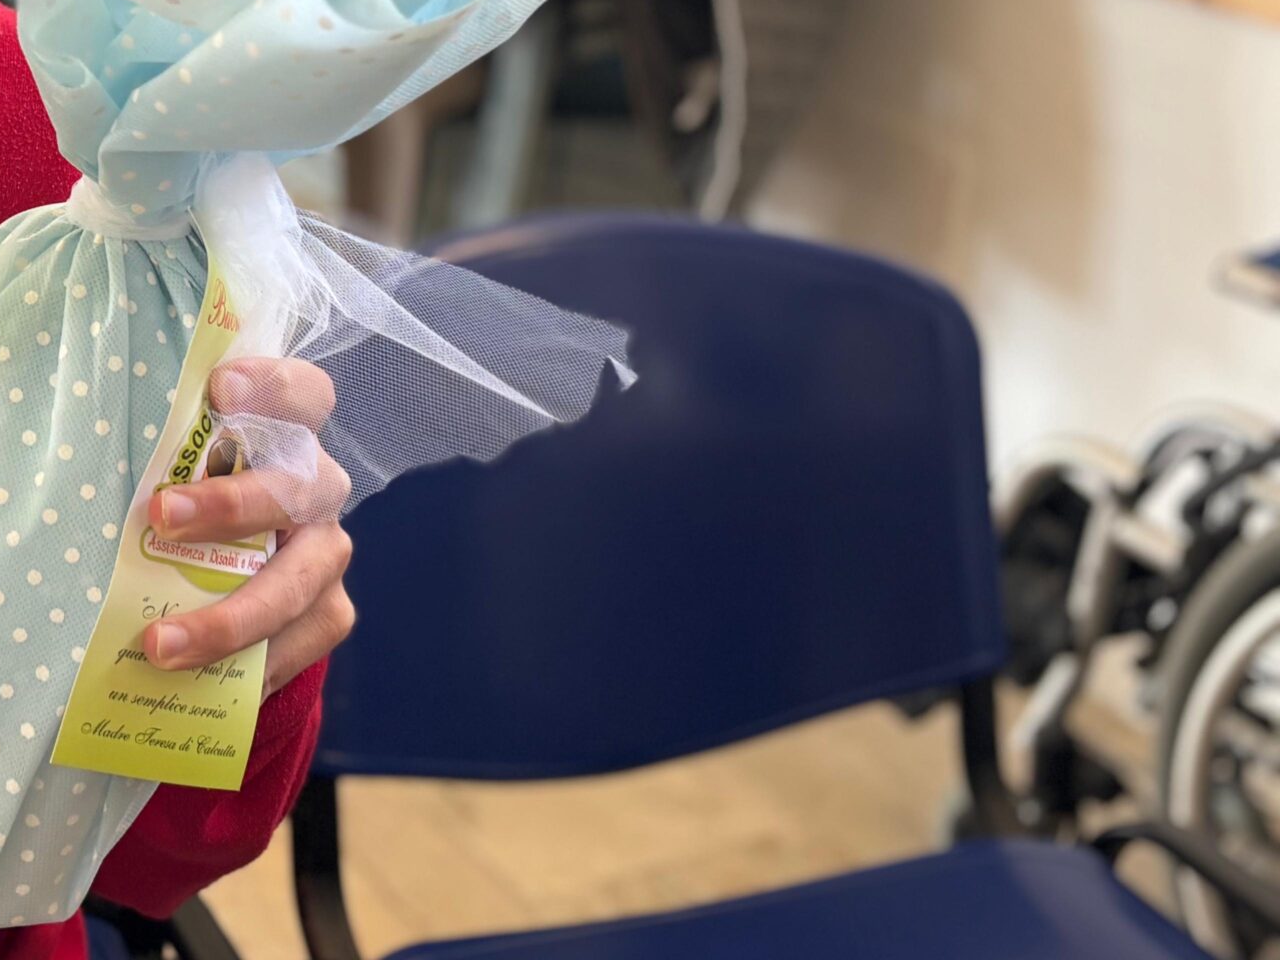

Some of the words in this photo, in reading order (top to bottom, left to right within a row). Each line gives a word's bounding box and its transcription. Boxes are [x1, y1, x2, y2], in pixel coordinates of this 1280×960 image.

[172, 414, 212, 485] SSOC
[148, 533, 205, 561] Assistenza
[219, 657, 246, 686] fare
[108, 690, 129, 704] un
[130, 692, 188, 716] semplice
[81, 718, 131, 742] Madre
[135, 727, 176, 751] Teresa
[178, 736, 194, 753] di
[196, 734, 238, 758] Calcutta
